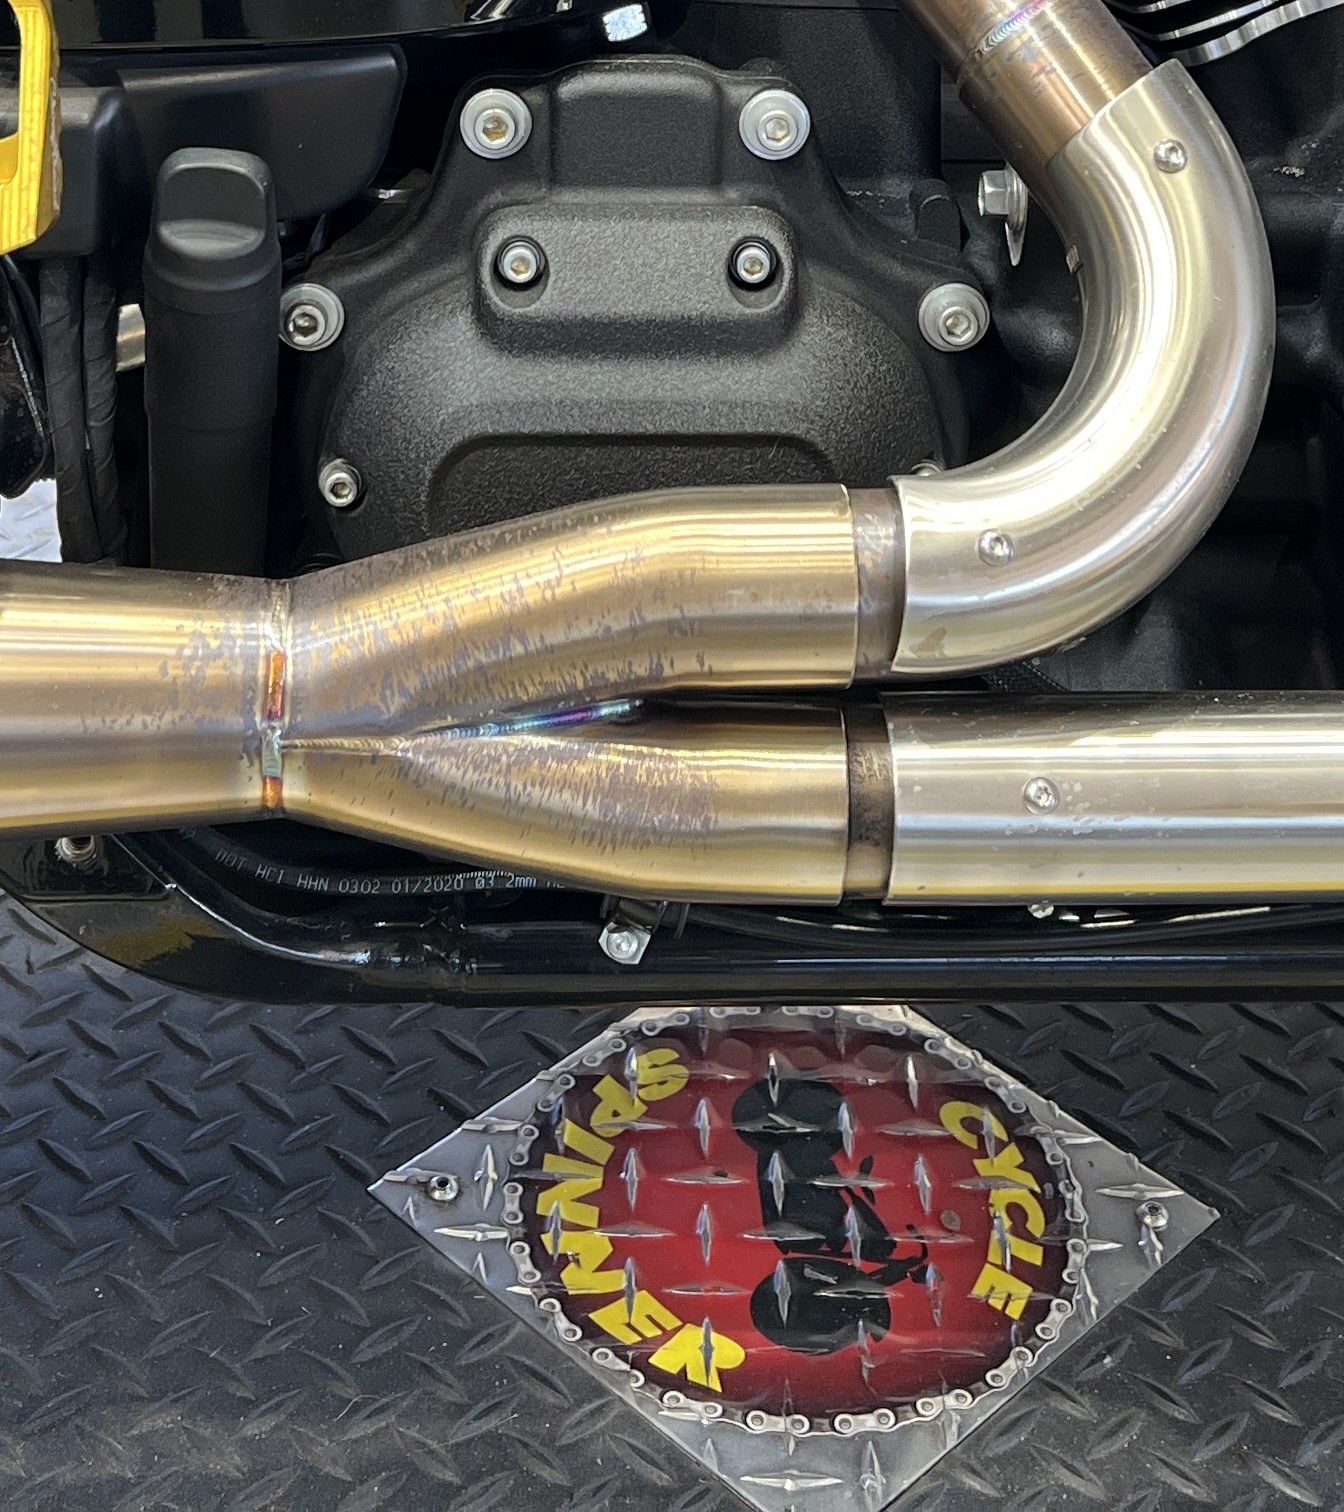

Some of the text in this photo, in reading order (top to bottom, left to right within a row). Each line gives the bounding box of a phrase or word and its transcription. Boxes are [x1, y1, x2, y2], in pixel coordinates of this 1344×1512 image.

[296, 872, 330, 892] HHN
[338, 877, 381, 895] 0302
[390, 874, 465, 894] 01/2020
[536, 1047, 747, 1393] SPINNER
[939, 1100, 1046, 1321] CYCLE
